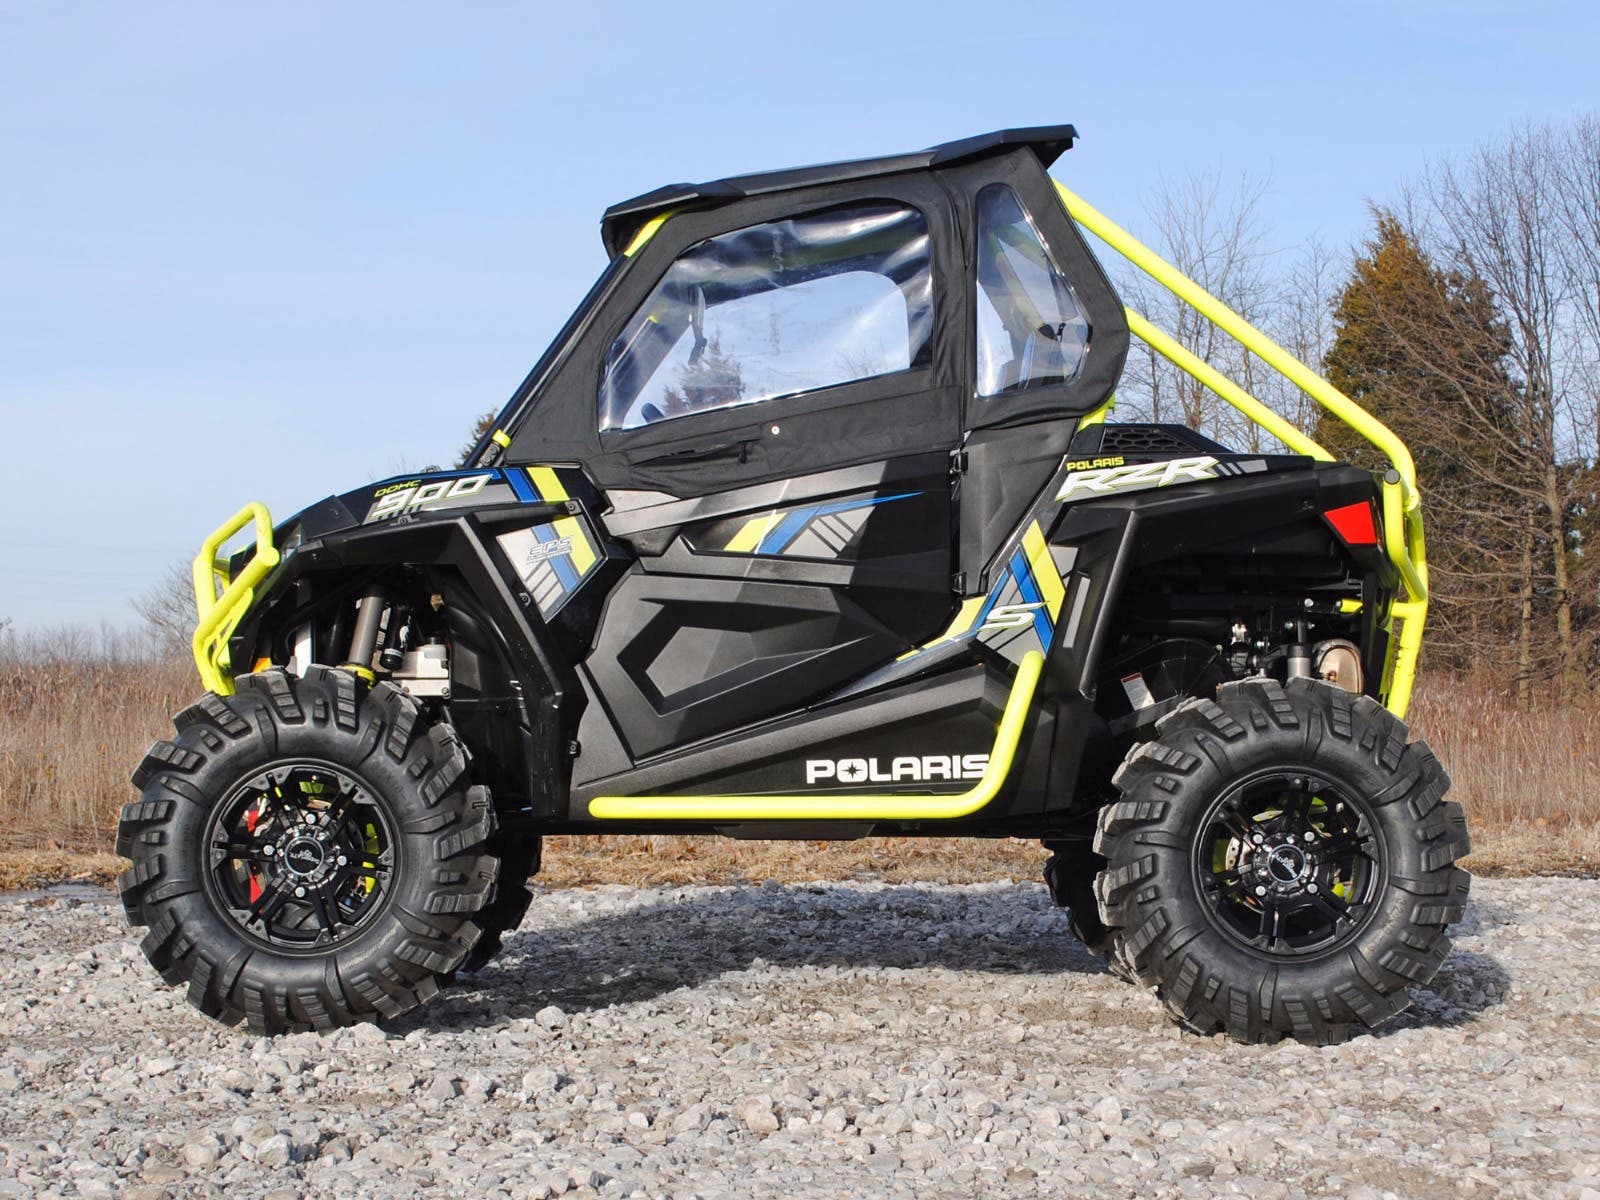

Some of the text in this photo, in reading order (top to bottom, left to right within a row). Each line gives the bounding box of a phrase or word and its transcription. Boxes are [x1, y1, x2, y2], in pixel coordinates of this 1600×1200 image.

[1055, 456, 1220, 502] RZR
[1066, 456, 1125, 471] POLARIS
[371, 474, 494, 520] 900
[374, 479, 422, 498] DOHC
[976, 600, 1050, 632] S
[806, 754, 990, 784] POLARIS
